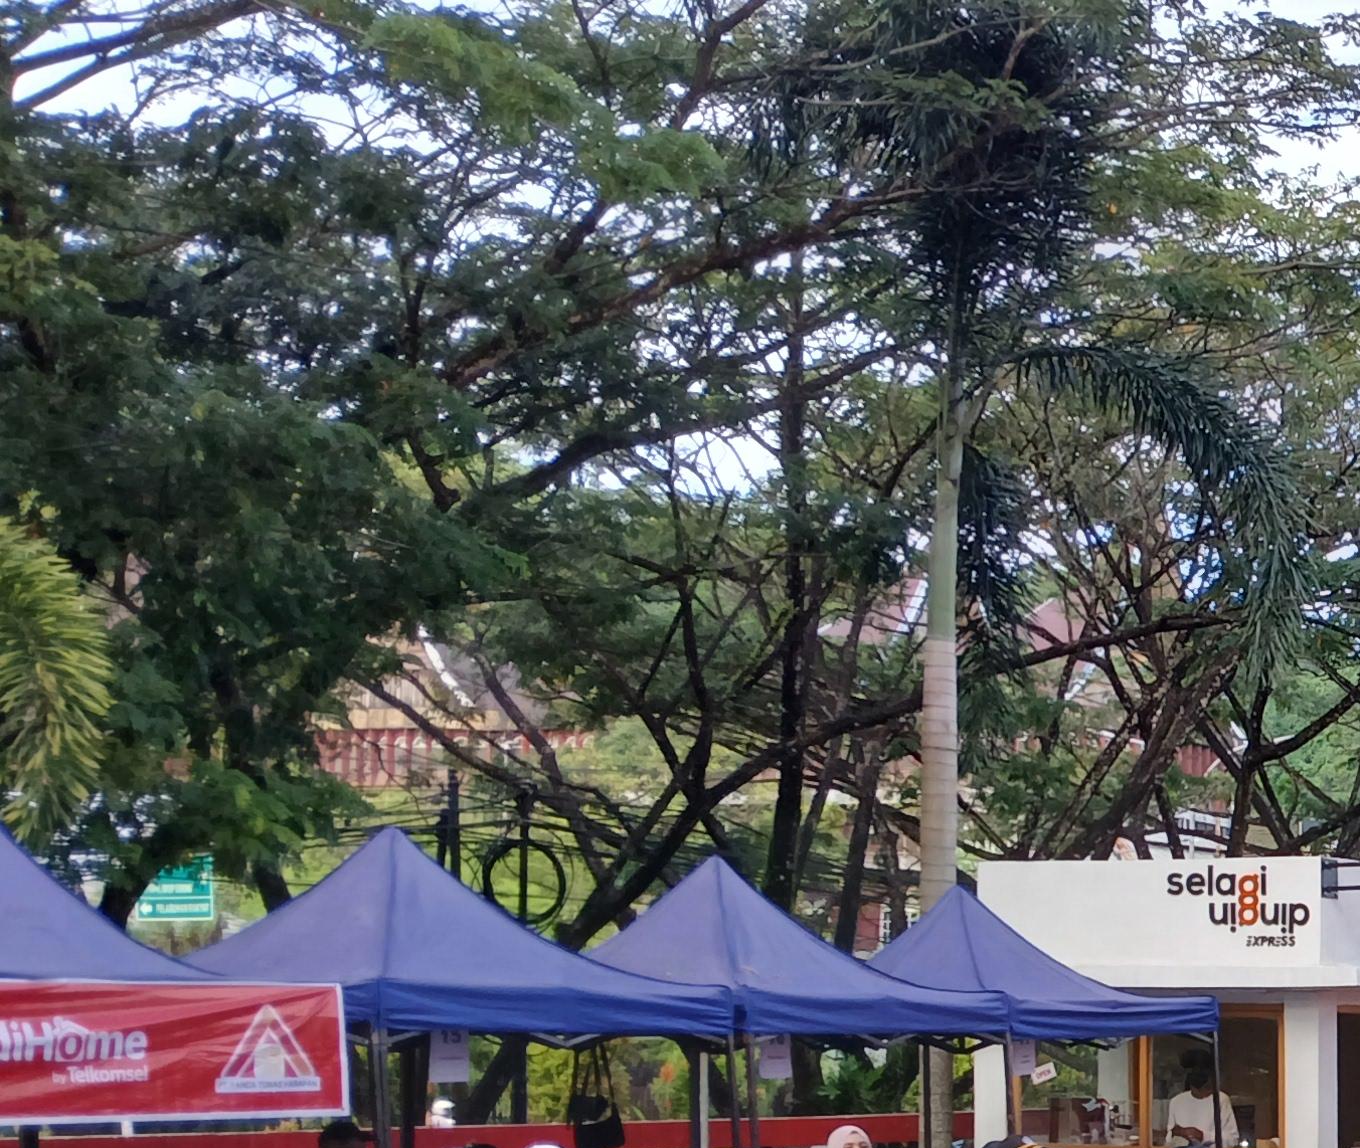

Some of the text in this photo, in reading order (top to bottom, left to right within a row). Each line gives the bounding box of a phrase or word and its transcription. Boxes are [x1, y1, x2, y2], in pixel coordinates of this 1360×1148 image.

[1166, 864, 1267, 897] selagi
[1245, 935, 1296, 947] EXPRESS
[66, 1064, 149, 1085] Telkomsel
